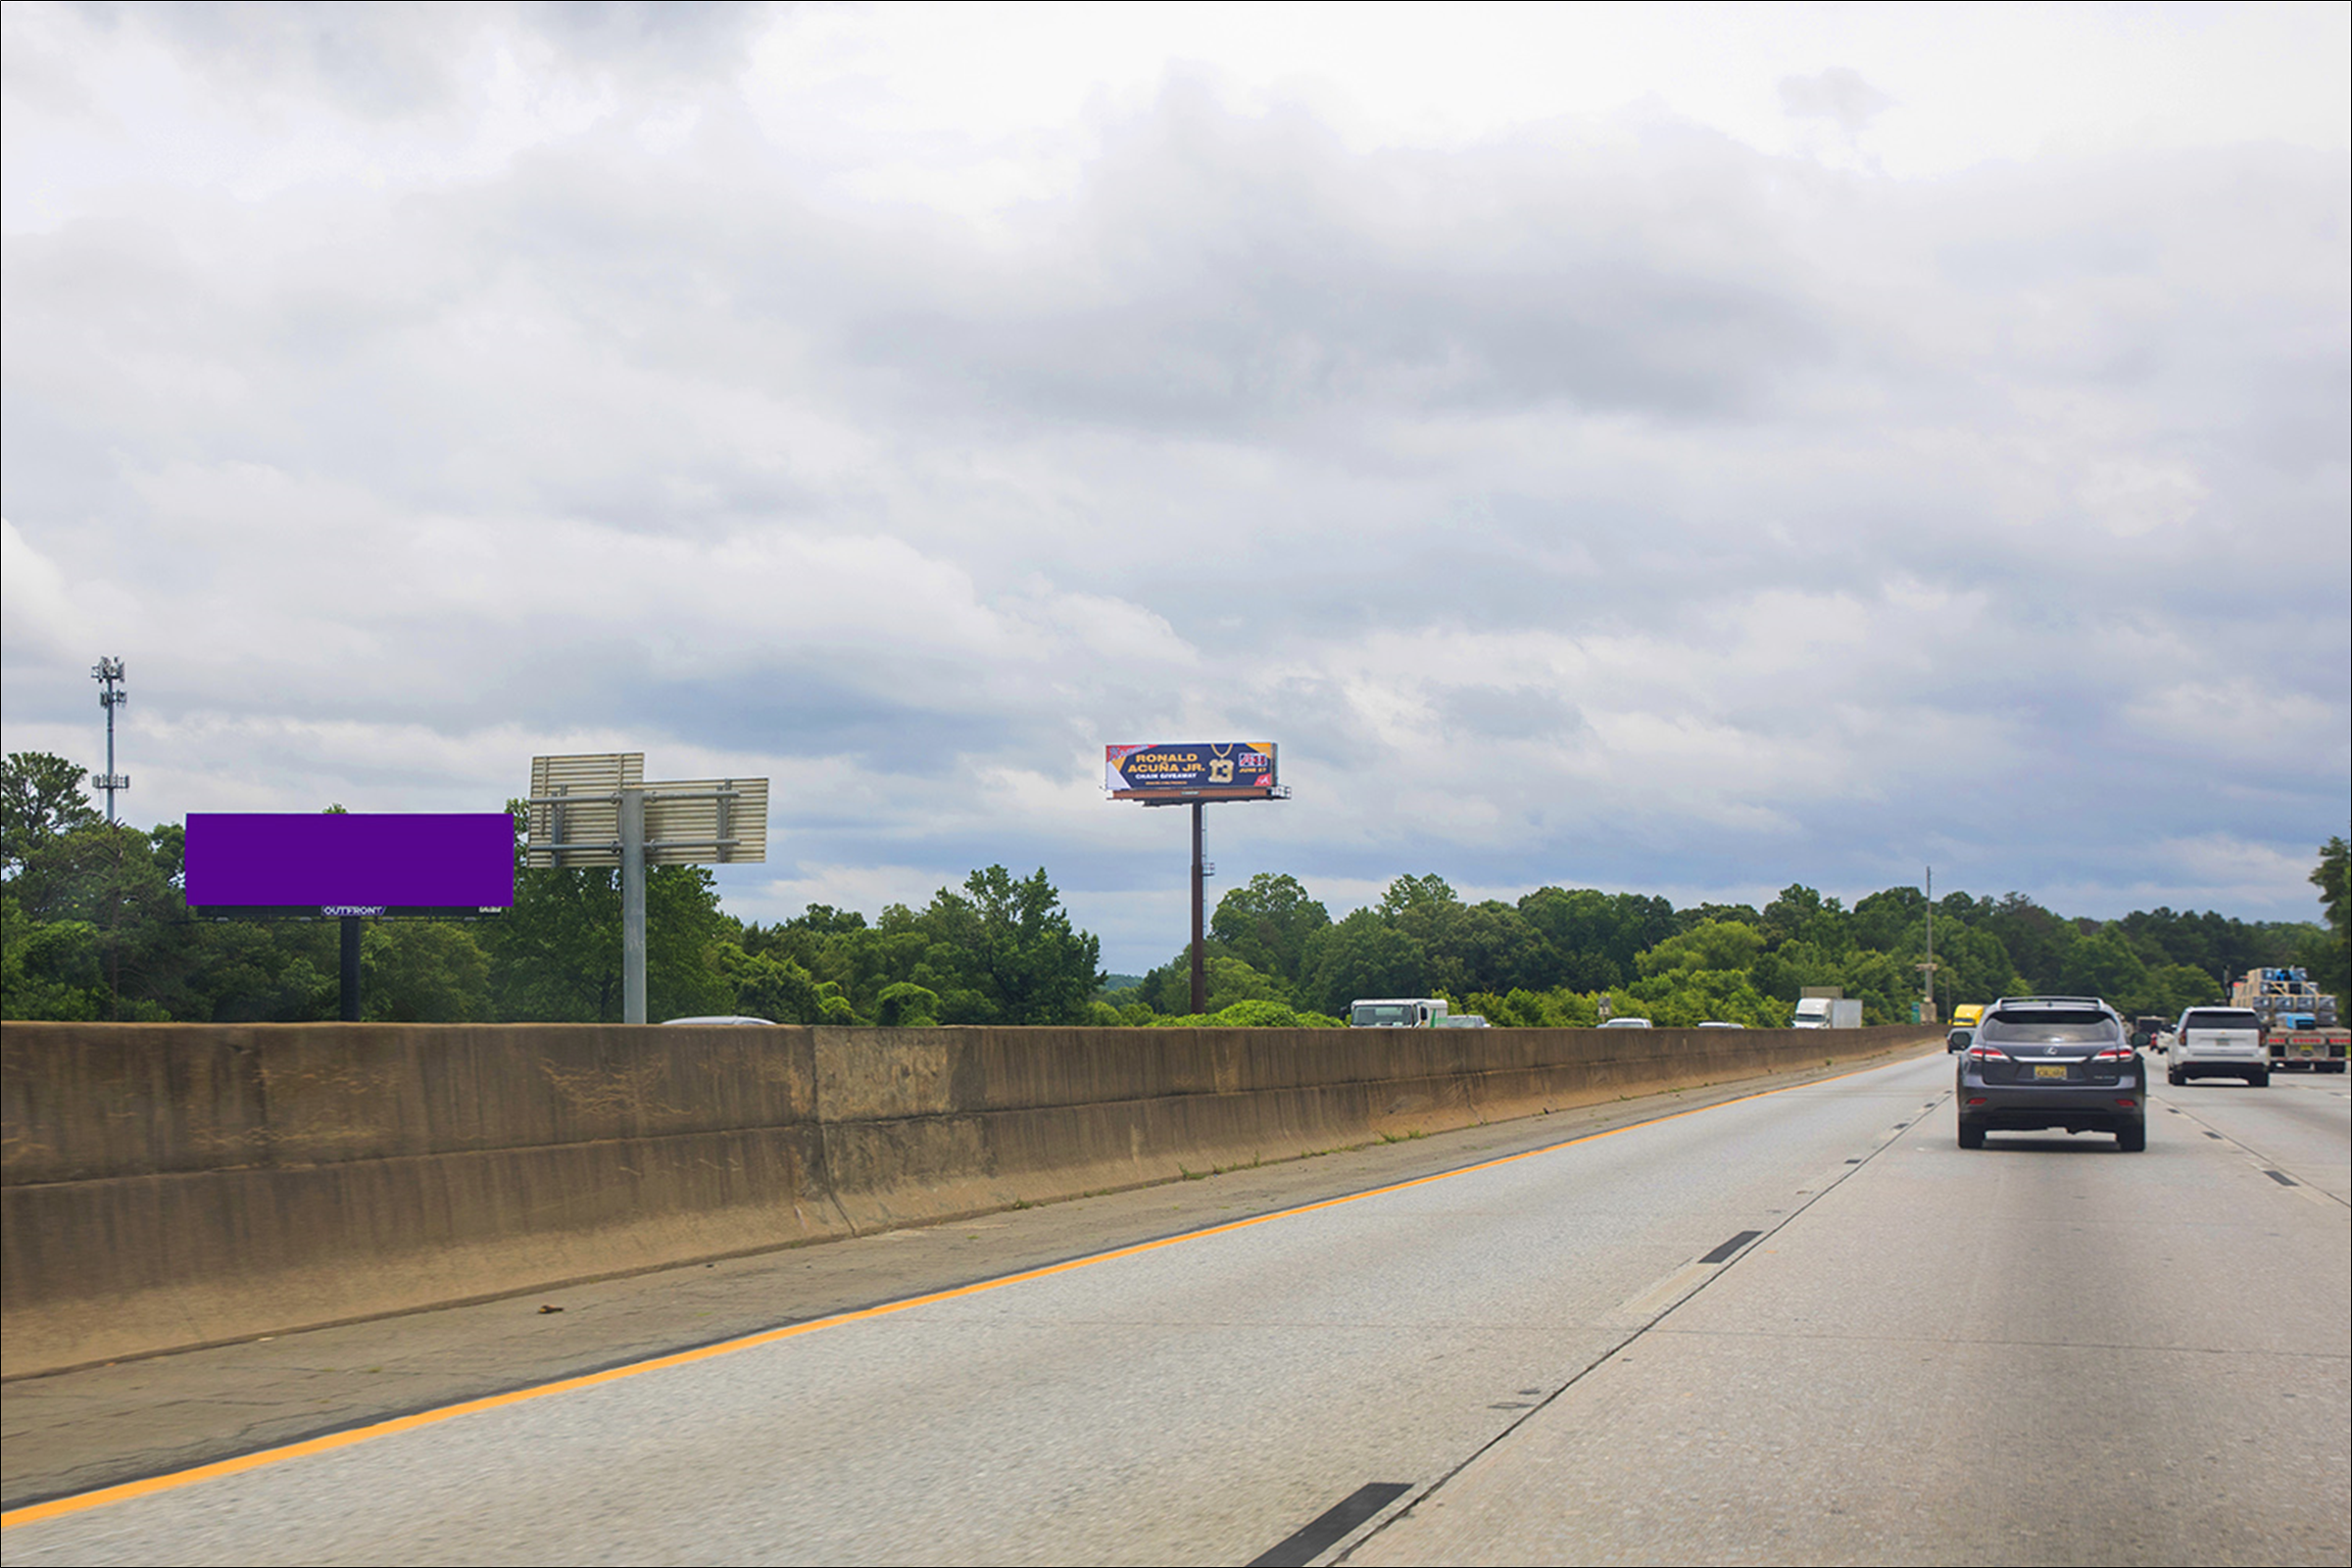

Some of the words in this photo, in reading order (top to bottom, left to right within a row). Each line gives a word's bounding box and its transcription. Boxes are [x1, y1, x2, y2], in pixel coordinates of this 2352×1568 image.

[1136, 753, 1198, 762] RONALD
[1127, 761, 1179, 773] ACUÑA
[1182, 762, 1205, 772] JR.
[323, 906, 382, 915] OUTFRONT
